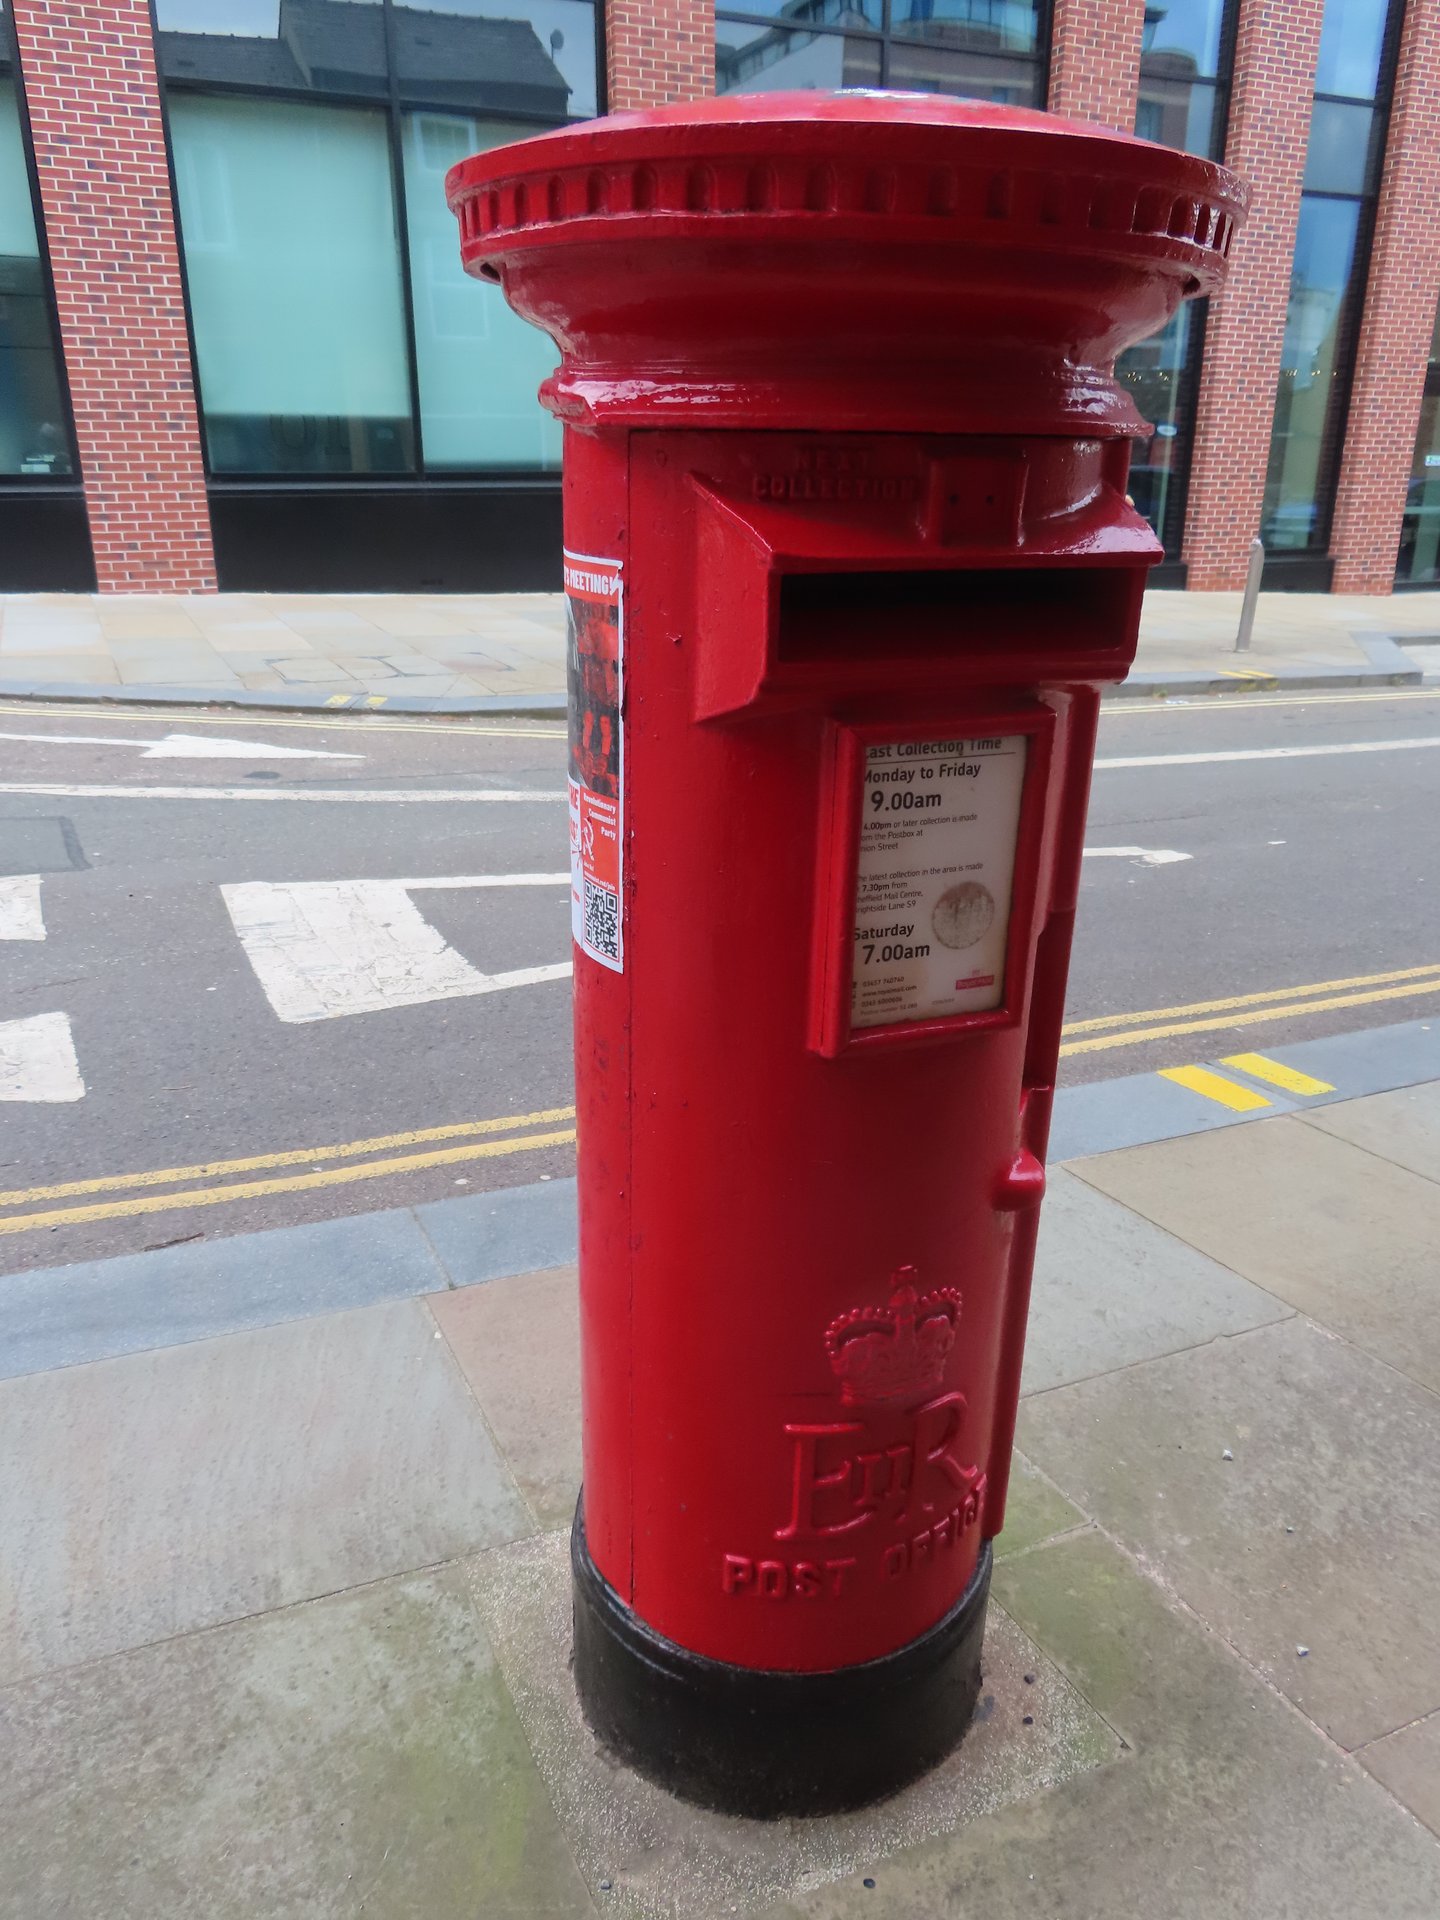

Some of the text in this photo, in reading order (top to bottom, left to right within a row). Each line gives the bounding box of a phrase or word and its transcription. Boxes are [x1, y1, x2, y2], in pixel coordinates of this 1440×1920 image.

[752, 473, 918, 501] COLLECTION
[570, 569, 614, 596] MEETING!
[920, 766, 934, 779] to
[939, 762, 981, 778] Friday
[583, 792, 616, 815] Revolutionary
[871, 789, 942, 812] 9.00am
[588, 807, 616, 827] Communist
[920, 815, 951, 826] collection
[600, 826, 616, 841] Party
[888, 830, 914, 839] Postbox
[878, 842, 899, 851] Street
[869, 873, 888, 881] latest
[889, 870, 921, 880] collection
[930, 867, 941, 875] the
[942, 866, 957, 874] area
[965, 862, 984, 871] made
[862, 883, 890, 892] 7.30pm
[891, 882, 908, 890] from
[857, 894, 883, 903] heffield
[884, 892, 899, 901] Mail
[857, 900, 917, 914] rightside Lane S9
[854, 923, 915, 940] Saturday
[862, 944, 930, 965] 7.00am
[722, 1553, 857, 1598] POST
